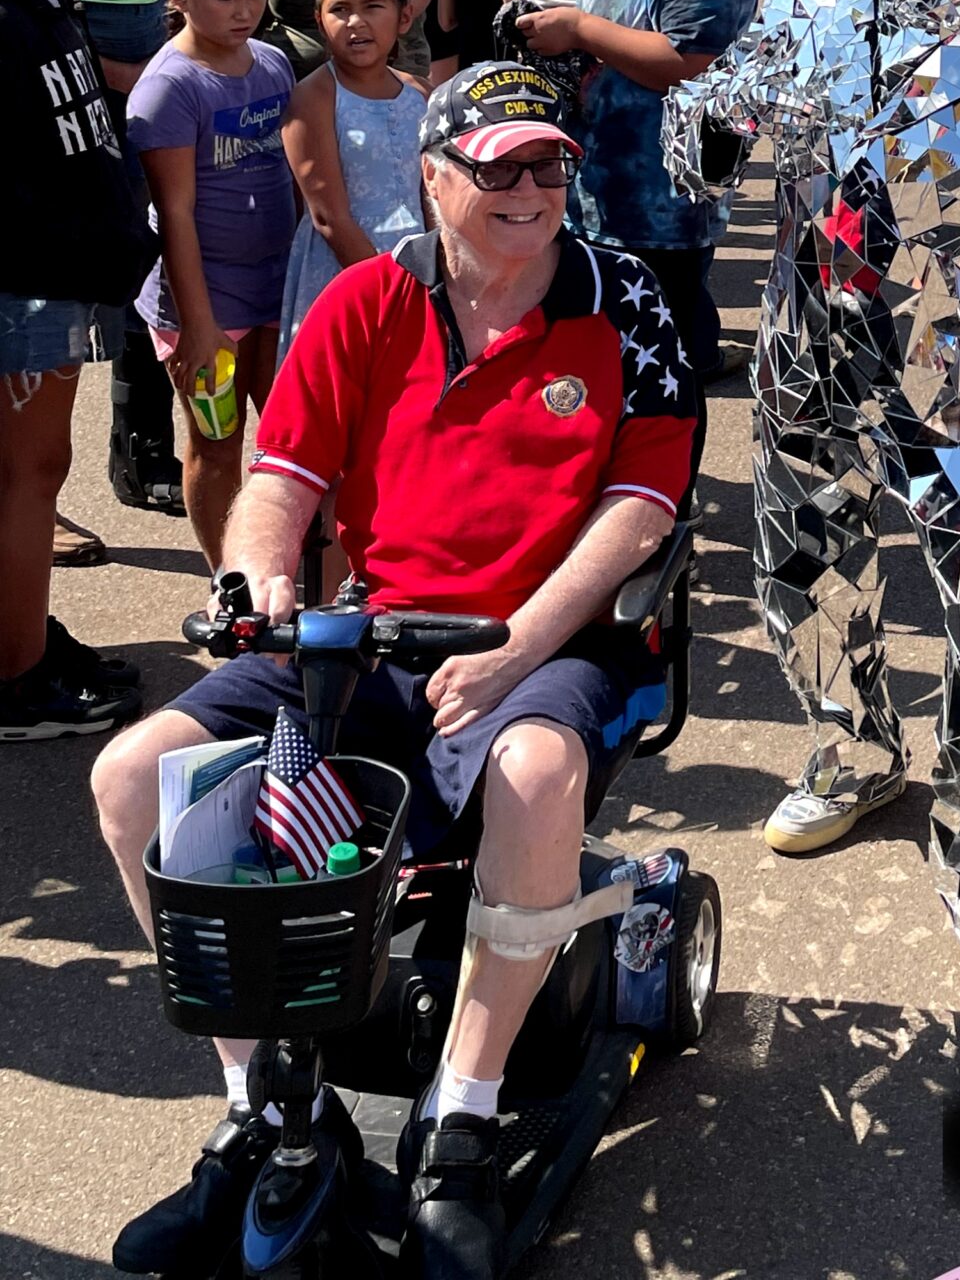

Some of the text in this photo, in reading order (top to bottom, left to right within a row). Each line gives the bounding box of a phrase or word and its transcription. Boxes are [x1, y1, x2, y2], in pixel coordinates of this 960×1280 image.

[468, 71, 558, 101] USS LEXINGTON
[240, 100, 280, 128] Original
[505, 102, 546, 116] CVA-16
